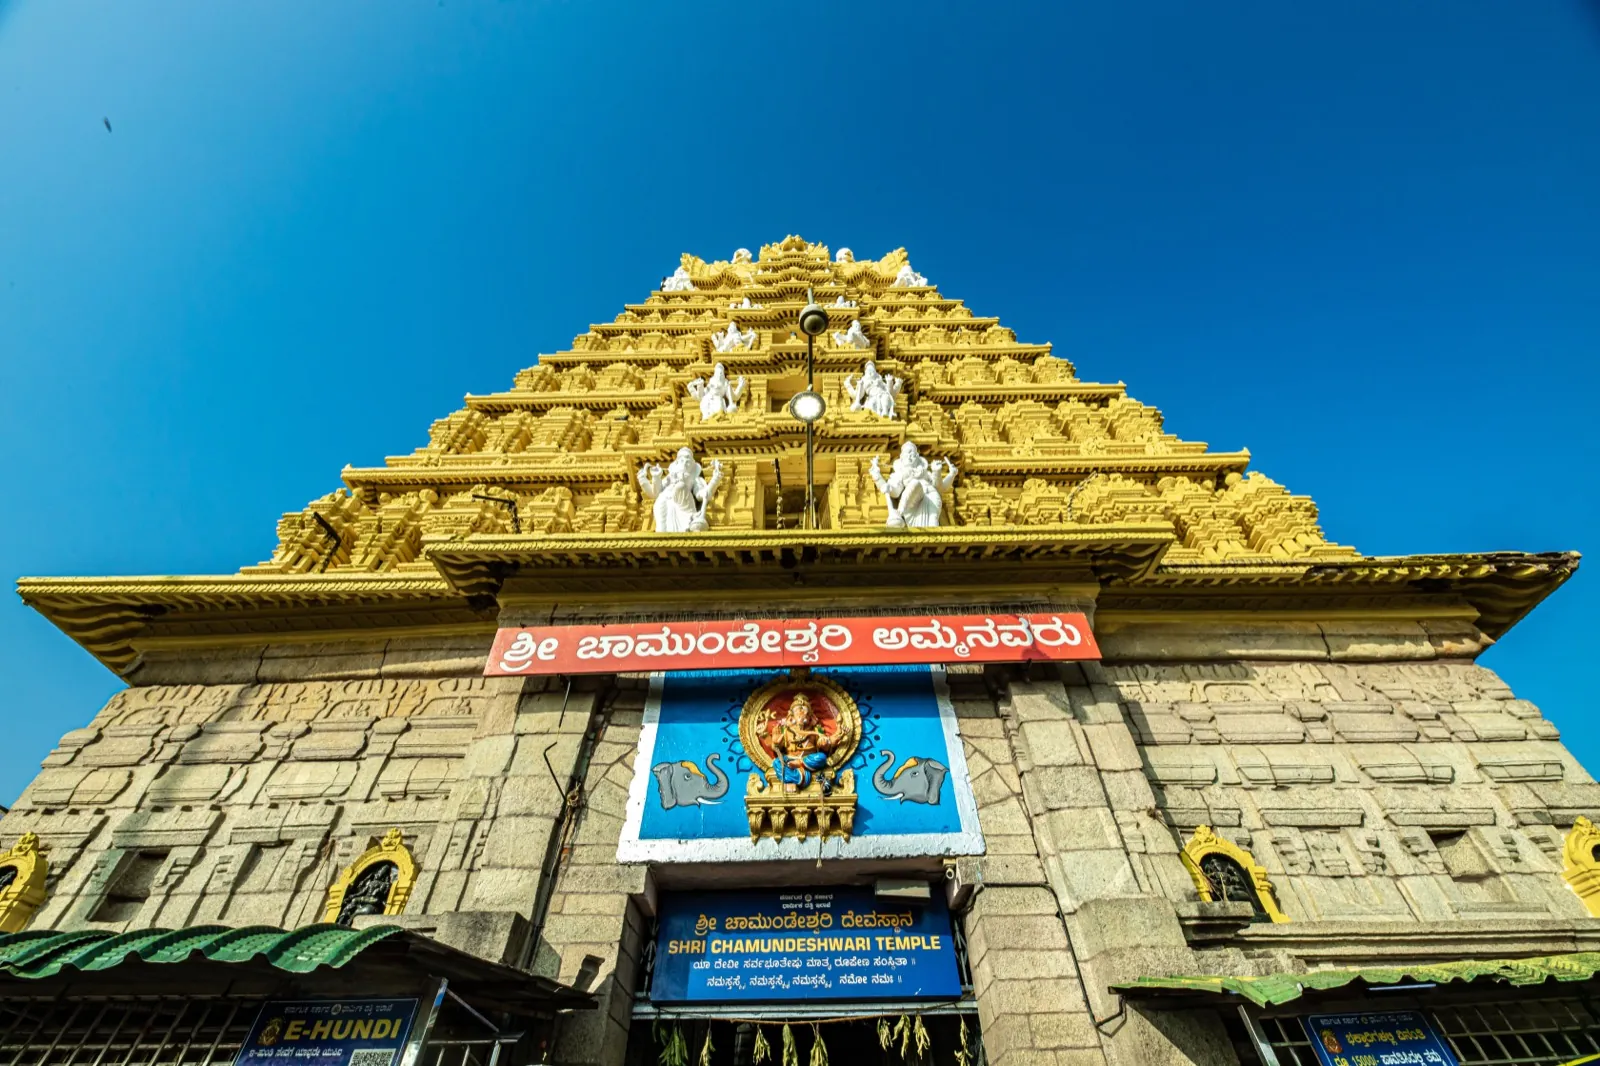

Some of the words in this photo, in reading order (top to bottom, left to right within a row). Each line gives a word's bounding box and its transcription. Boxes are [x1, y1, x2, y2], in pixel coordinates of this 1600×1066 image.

[499, 630, 557, 672] ಶ್ರೀ
[576, 622, 853, 662] ಚಾಮುಂಡೇಶ್ವರಿ
[872, 614, 1082, 658] ಅಮ್ಮನವರು
[694, 913, 717, 936] ಶ್ರೀ
[725, 911, 833, 934] ಚಾಮುಂಡೇಶ್ವರಿ
[841, 910, 913, 933] ದೇವಸ್ಥಾನ
[668, 940, 706, 954] SHRI
[711, 936, 871, 954] CHAMUNDESHWARI
[875, 935, 941, 951] TEMPLE
[693, 959, 711, 969] ಯಾ
[283, 1018, 402, 1040] E-HUNDI
